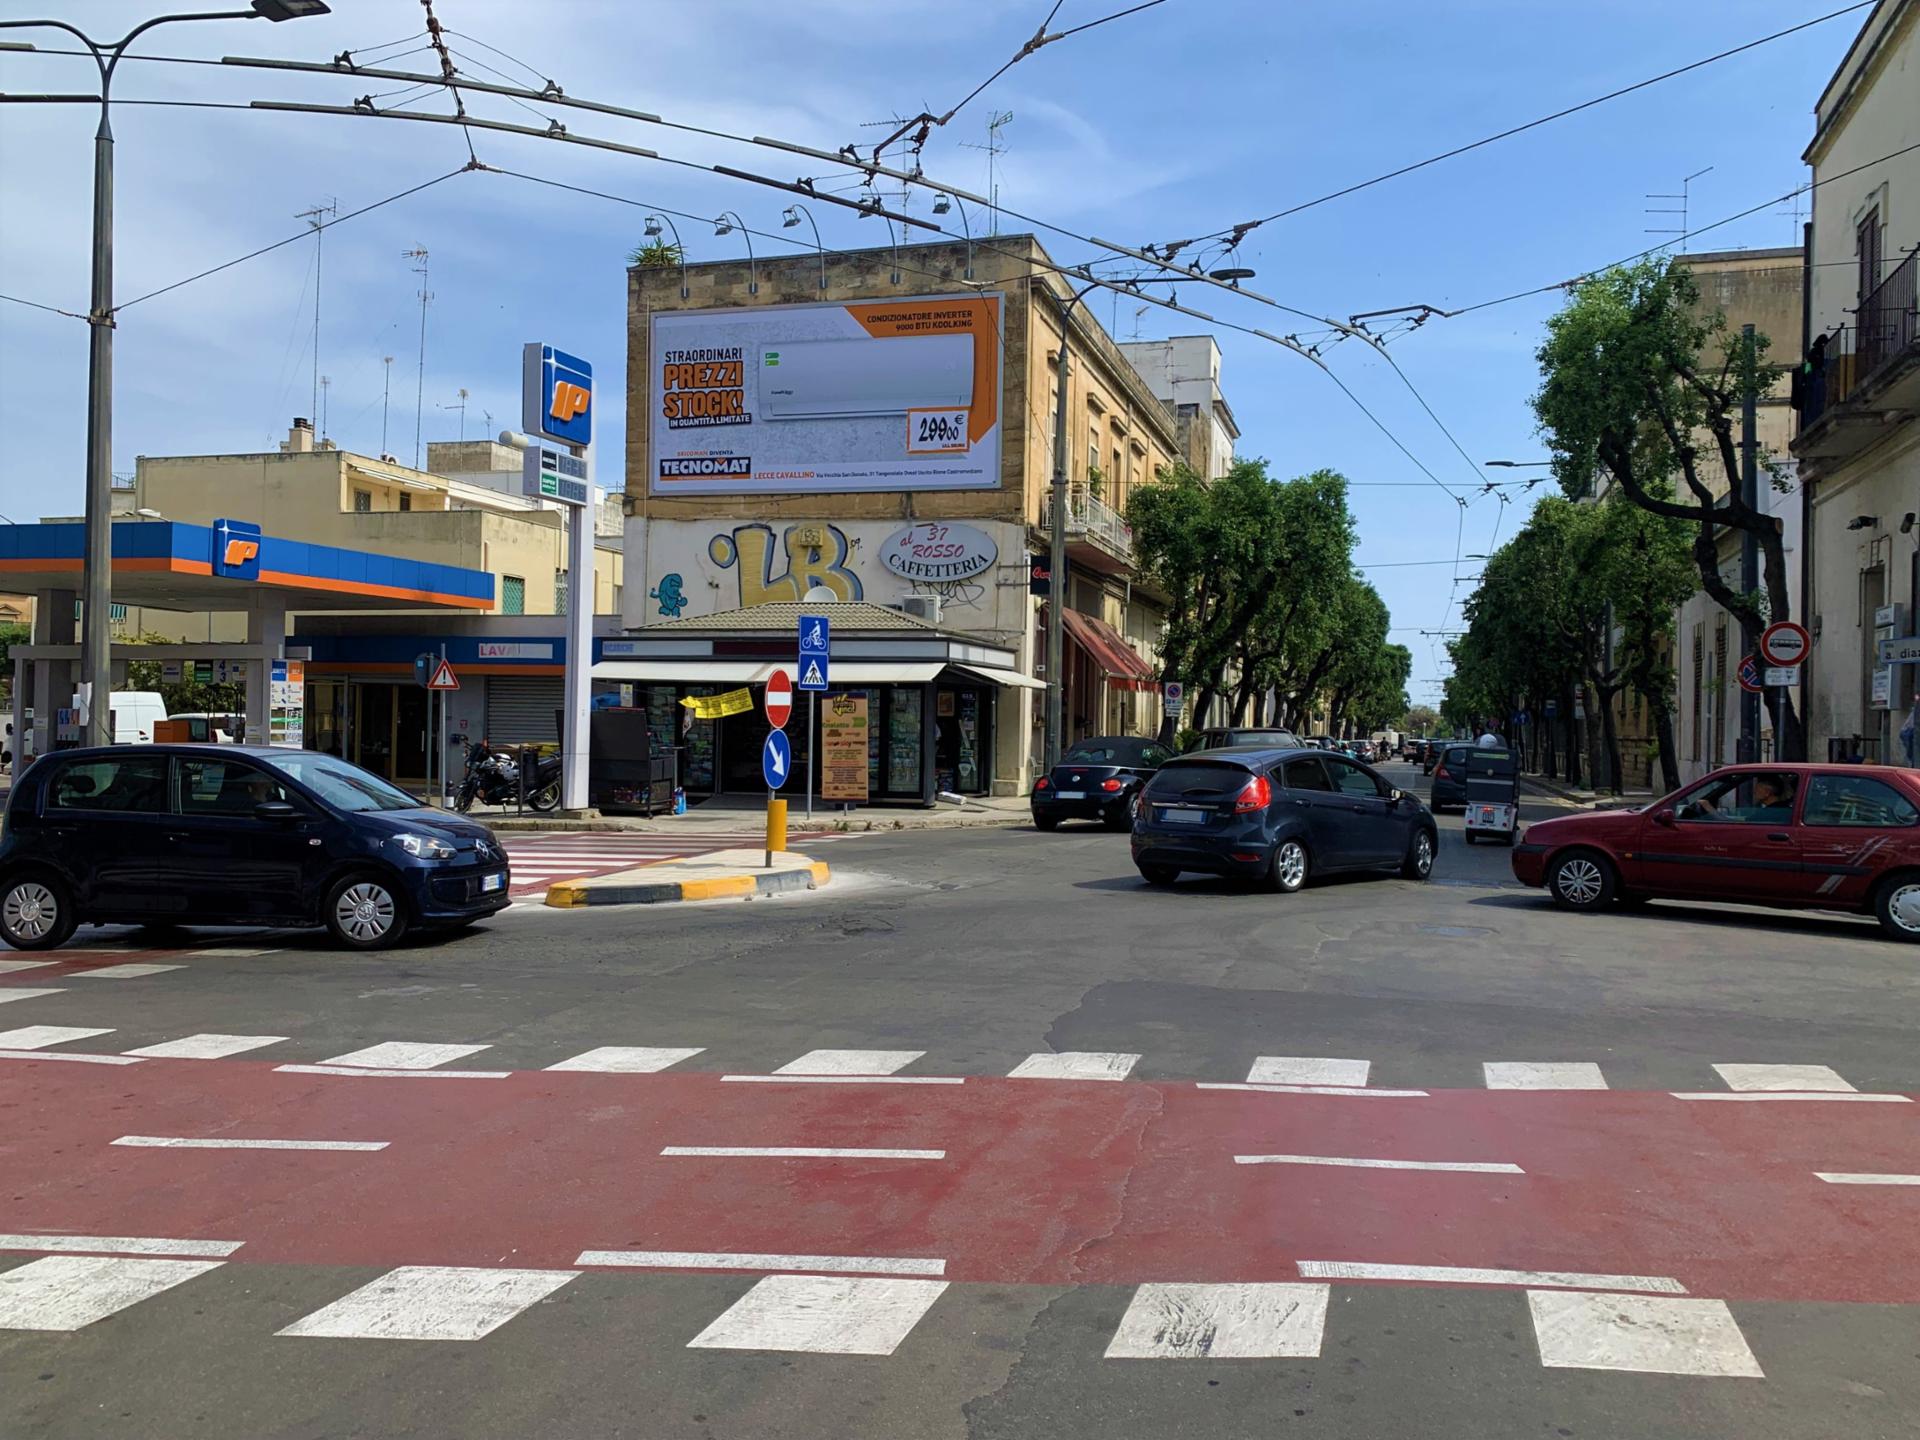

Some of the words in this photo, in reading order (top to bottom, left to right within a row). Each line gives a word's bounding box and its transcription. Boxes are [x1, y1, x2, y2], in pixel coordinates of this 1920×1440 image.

[867, 312, 932, 323] CONDIZIONATORE
[933, 310, 972, 320] INVERTER
[915, 321, 931, 330] BTU
[932, 319, 972, 329] KOOLKING
[665, 347, 742, 362] STRAORDINARI
[664, 361, 743, 390] PREZZI
[663, 389, 743, 418] STOCK!
[716, 414, 750, 424] LIMITATE
[662, 459, 749, 475] TECNOMAT
[754, 471, 775, 480] LECCE
[776, 470, 815, 479] CAVALLINO
[900, 532, 913, 547] al
[927, 527, 949, 541] 37
[912, 544, 965, 559] ROSSO
[889, 553, 989, 578] CAFFETTERIA
